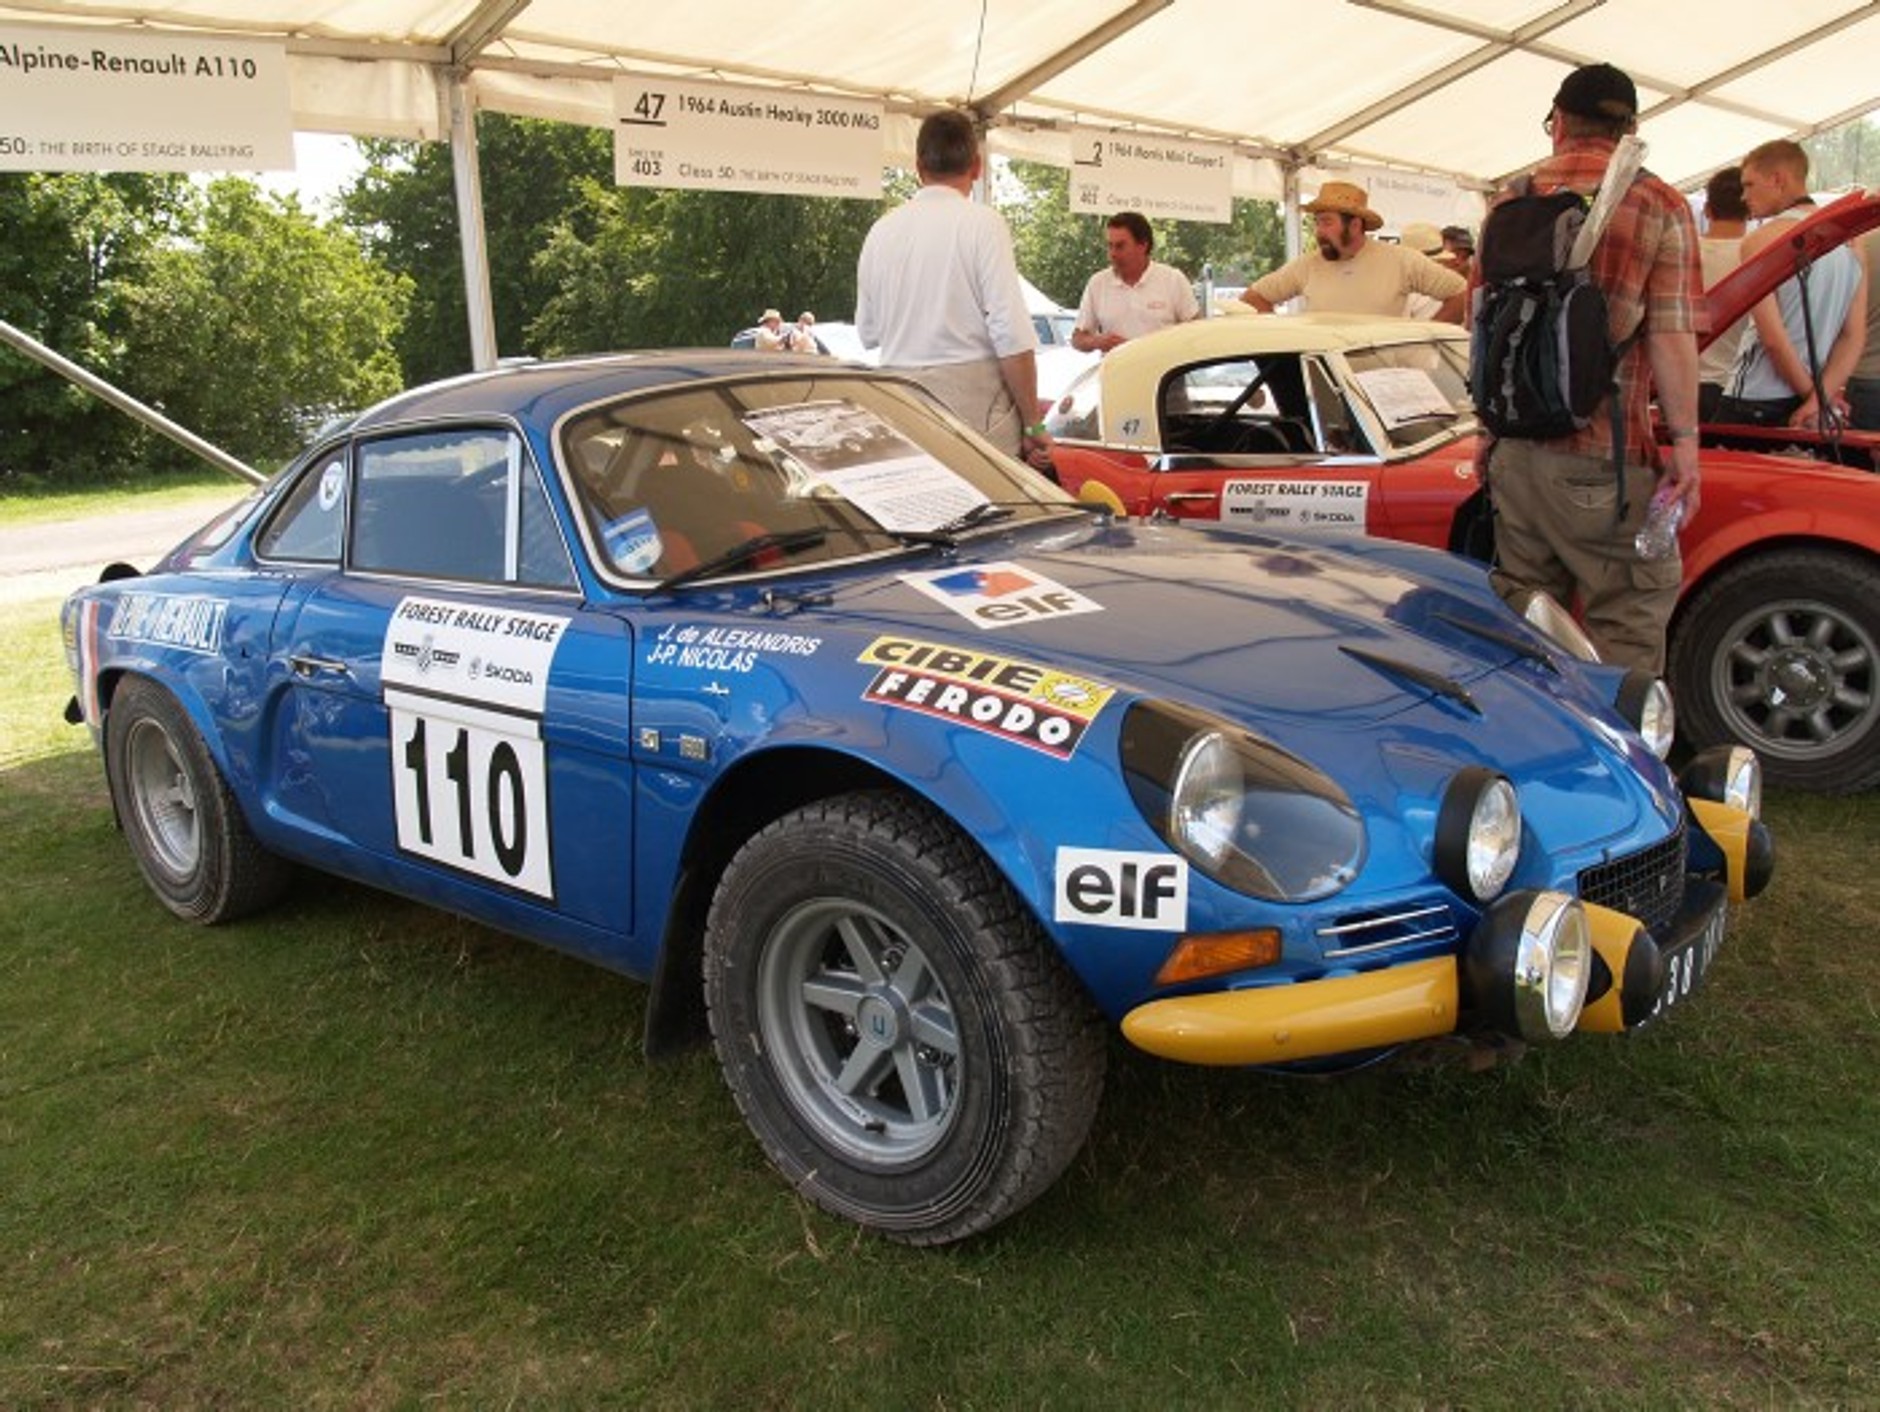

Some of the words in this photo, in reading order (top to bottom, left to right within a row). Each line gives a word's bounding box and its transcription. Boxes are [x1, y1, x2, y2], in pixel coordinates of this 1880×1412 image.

[0, 43, 187, 76] Alpine-Renault
[195, 56, 257, 79] A110
[634, 92, 666, 119] 47
[678, 94, 716, 114] 1964
[719, 98, 762, 119] Austin
[766, 104, 812, 127] Healey
[816, 109, 849, 127] 3000
[852, 112, 880, 131] Mk3
[40, 142, 65, 155] THE
[73, 142, 112, 156] BIRTH
[118, 142, 138, 157] OF
[142, 143, 187, 158] STAGE
[632, 158, 662, 176] 403
[1123, 418, 1140, 436] 47
[1227, 483, 1275, 496] FOREST
[1277, 483, 1317, 496] RALLY
[1321, 483, 1364, 498] STAGE
[398, 601, 454, 625] FOREST
[454, 608, 504, 634] RALLY
[503, 616, 560, 643] STAGE
[974, 593, 1076, 622] elf
[677, 626, 699, 643] de
[700, 627, 823, 657] ALEXANDRIS
[677, 646, 758, 673] NICOLAS
[872, 641, 1044, 694] CIBIE
[875, 671, 1072, 745] FERODO
[405, 716, 528, 878] 110
[1065, 861, 1178, 920] elf
